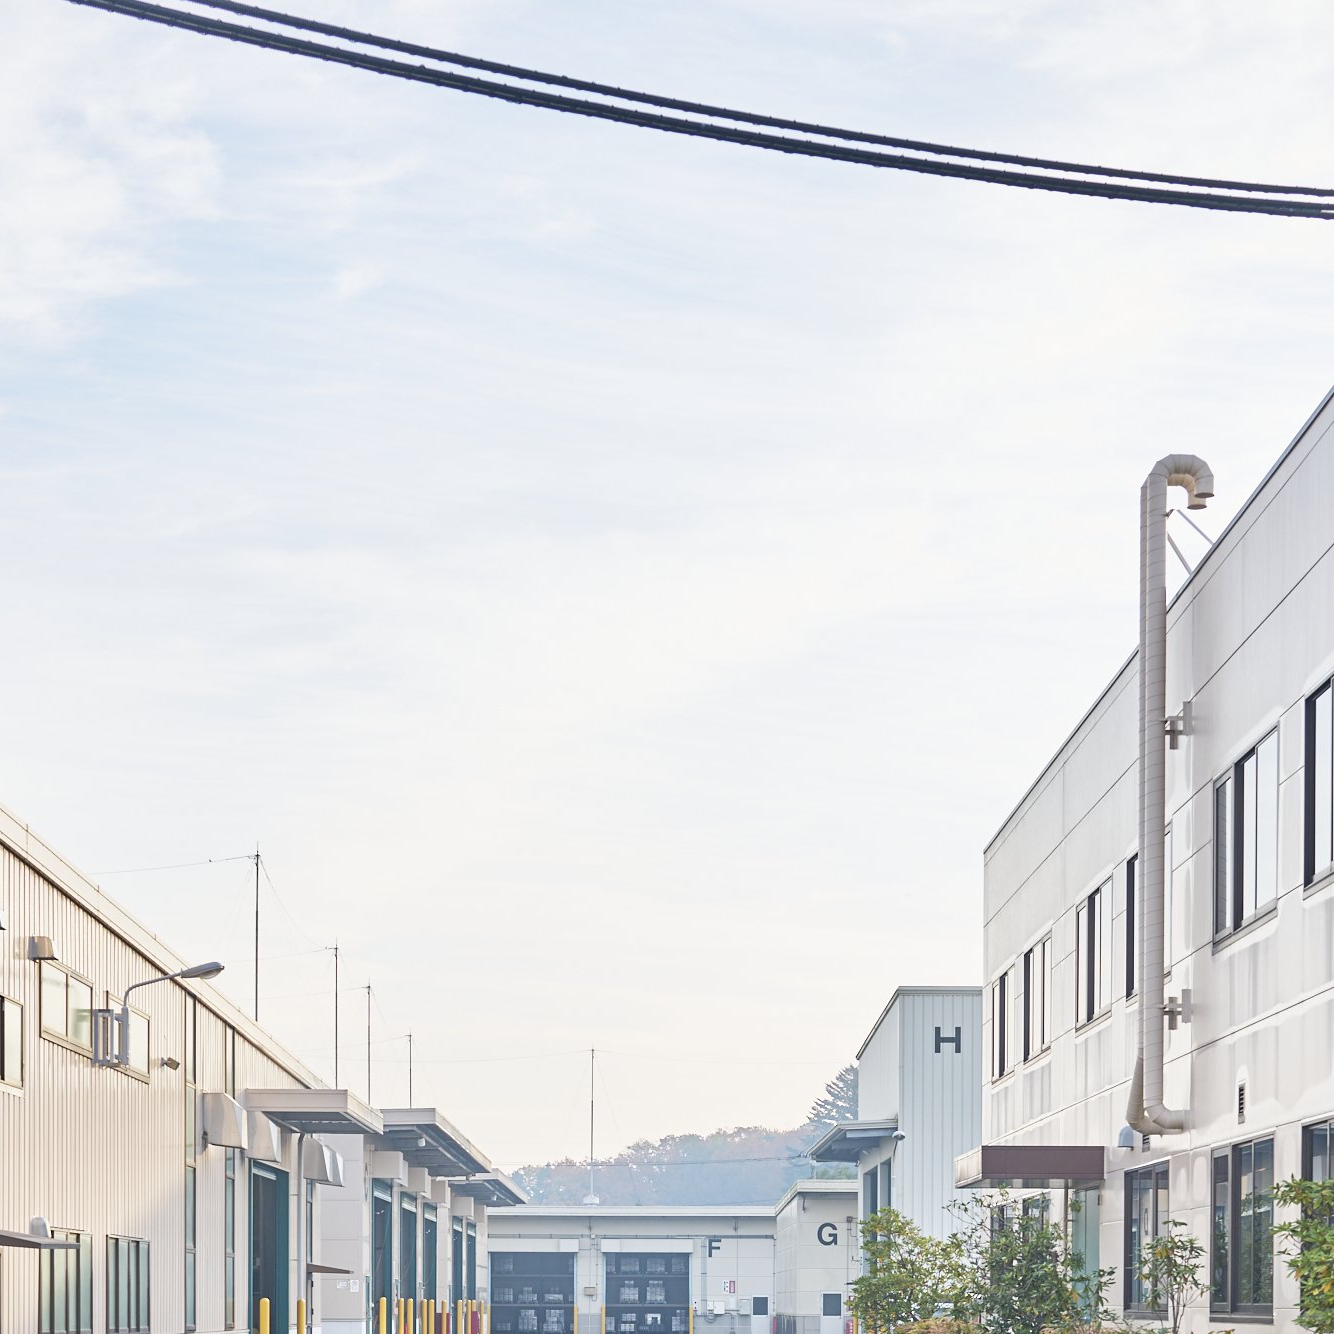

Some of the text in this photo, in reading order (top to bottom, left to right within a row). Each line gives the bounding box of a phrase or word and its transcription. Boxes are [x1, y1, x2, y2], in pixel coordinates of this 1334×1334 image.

[934, 1026, 962, 1054] H
[817, 1222, 838, 1246] G
[708, 1239, 722, 1258] F
